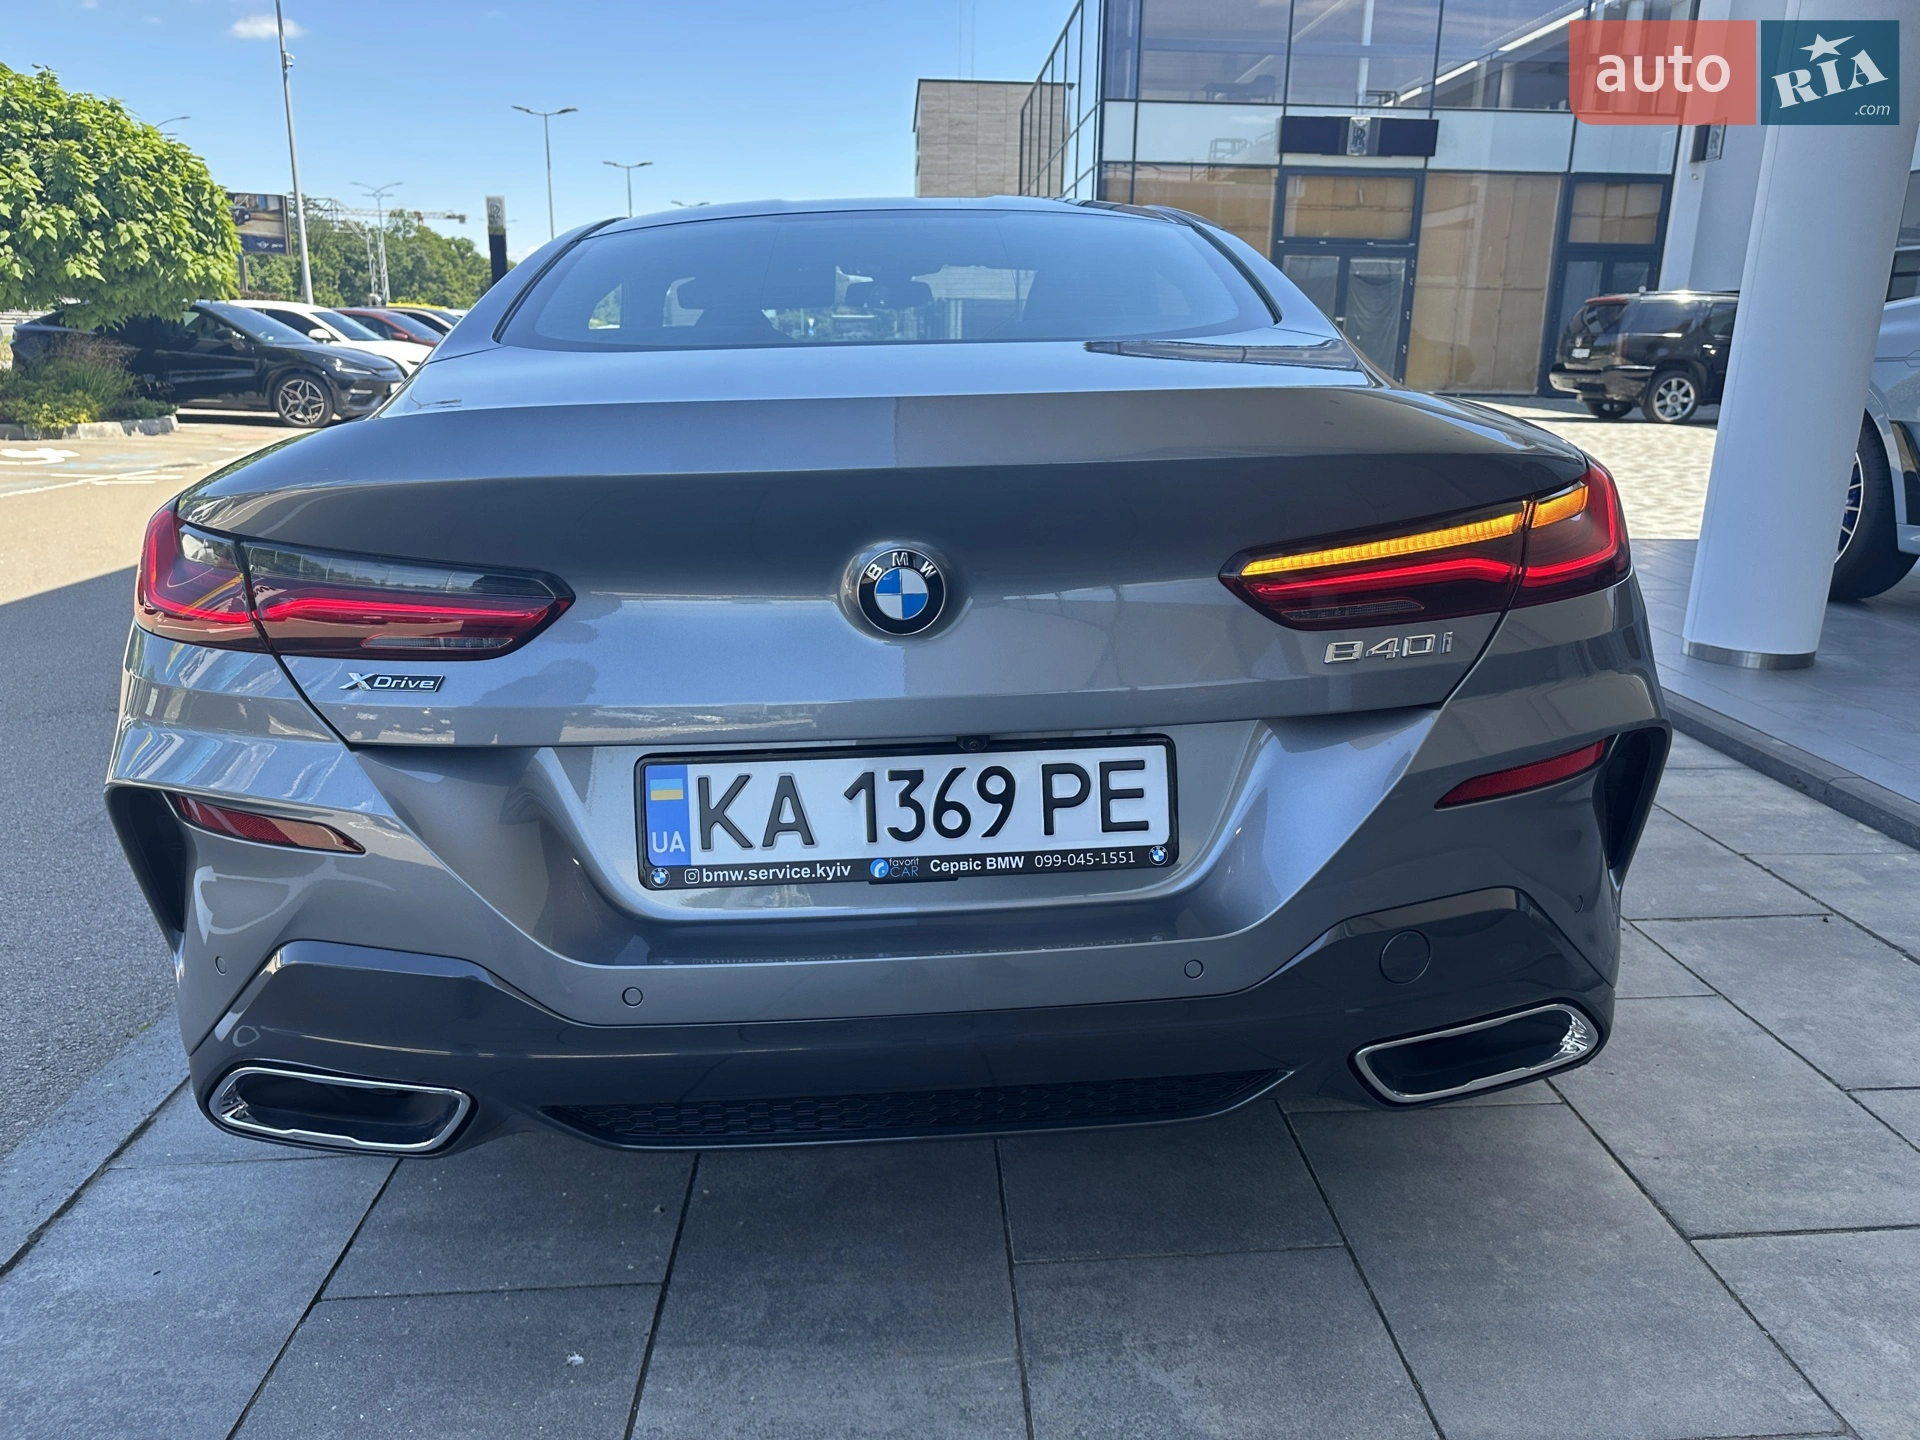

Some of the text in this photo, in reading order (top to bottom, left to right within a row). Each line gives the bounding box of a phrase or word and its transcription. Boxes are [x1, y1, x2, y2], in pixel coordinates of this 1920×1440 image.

[865, 552, 937, 581] BMW
[1323, 631, 1453, 664] 840i
[697, 759, 1149, 850] KA 1369 PE
[652, 831, 686, 853] UA
[702, 862, 851, 882] bmw.service.kyiv
[889, 857, 919, 867] favorit
[889, 866, 919, 878] CAR
[930, 850, 1136, 874] Сервіс BMW 099-045-1551
